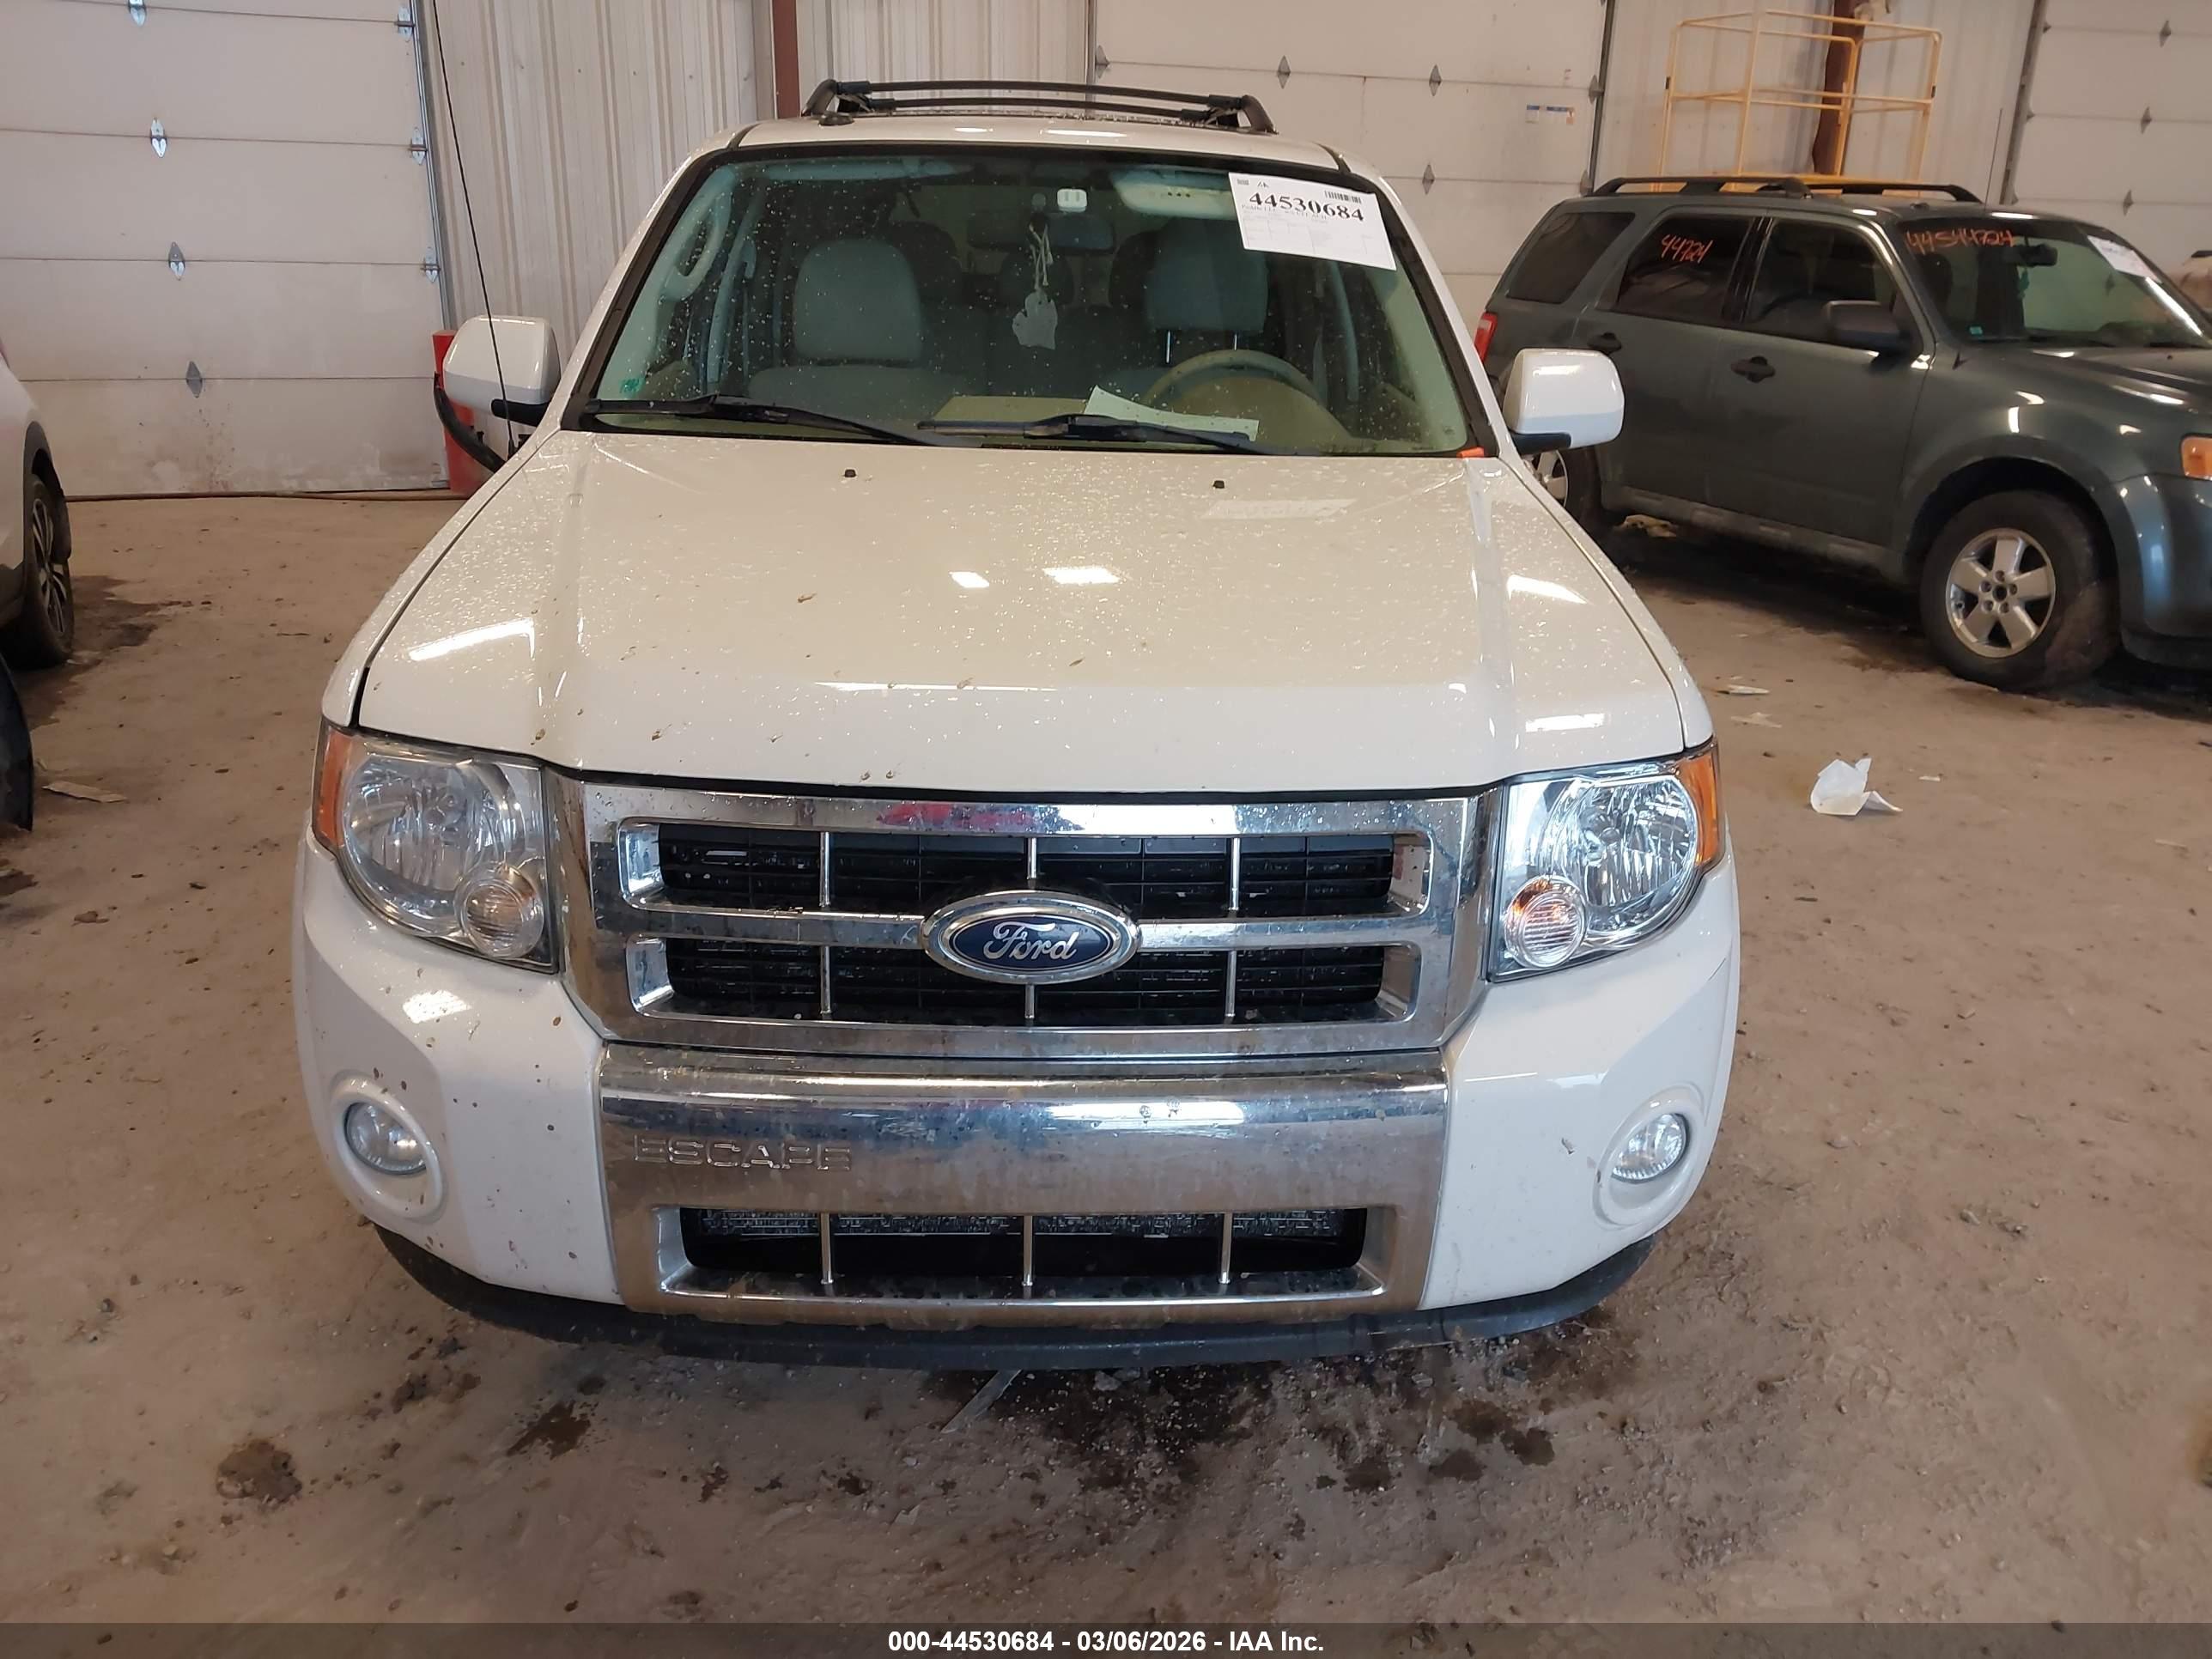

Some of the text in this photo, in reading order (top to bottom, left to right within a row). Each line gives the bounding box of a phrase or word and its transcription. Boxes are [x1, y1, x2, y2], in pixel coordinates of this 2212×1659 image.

[1249, 191, 1364, 222] 44530684
[982, 921, 1079, 960] Ford
[634, 1133, 852, 1171] ESCAPE
